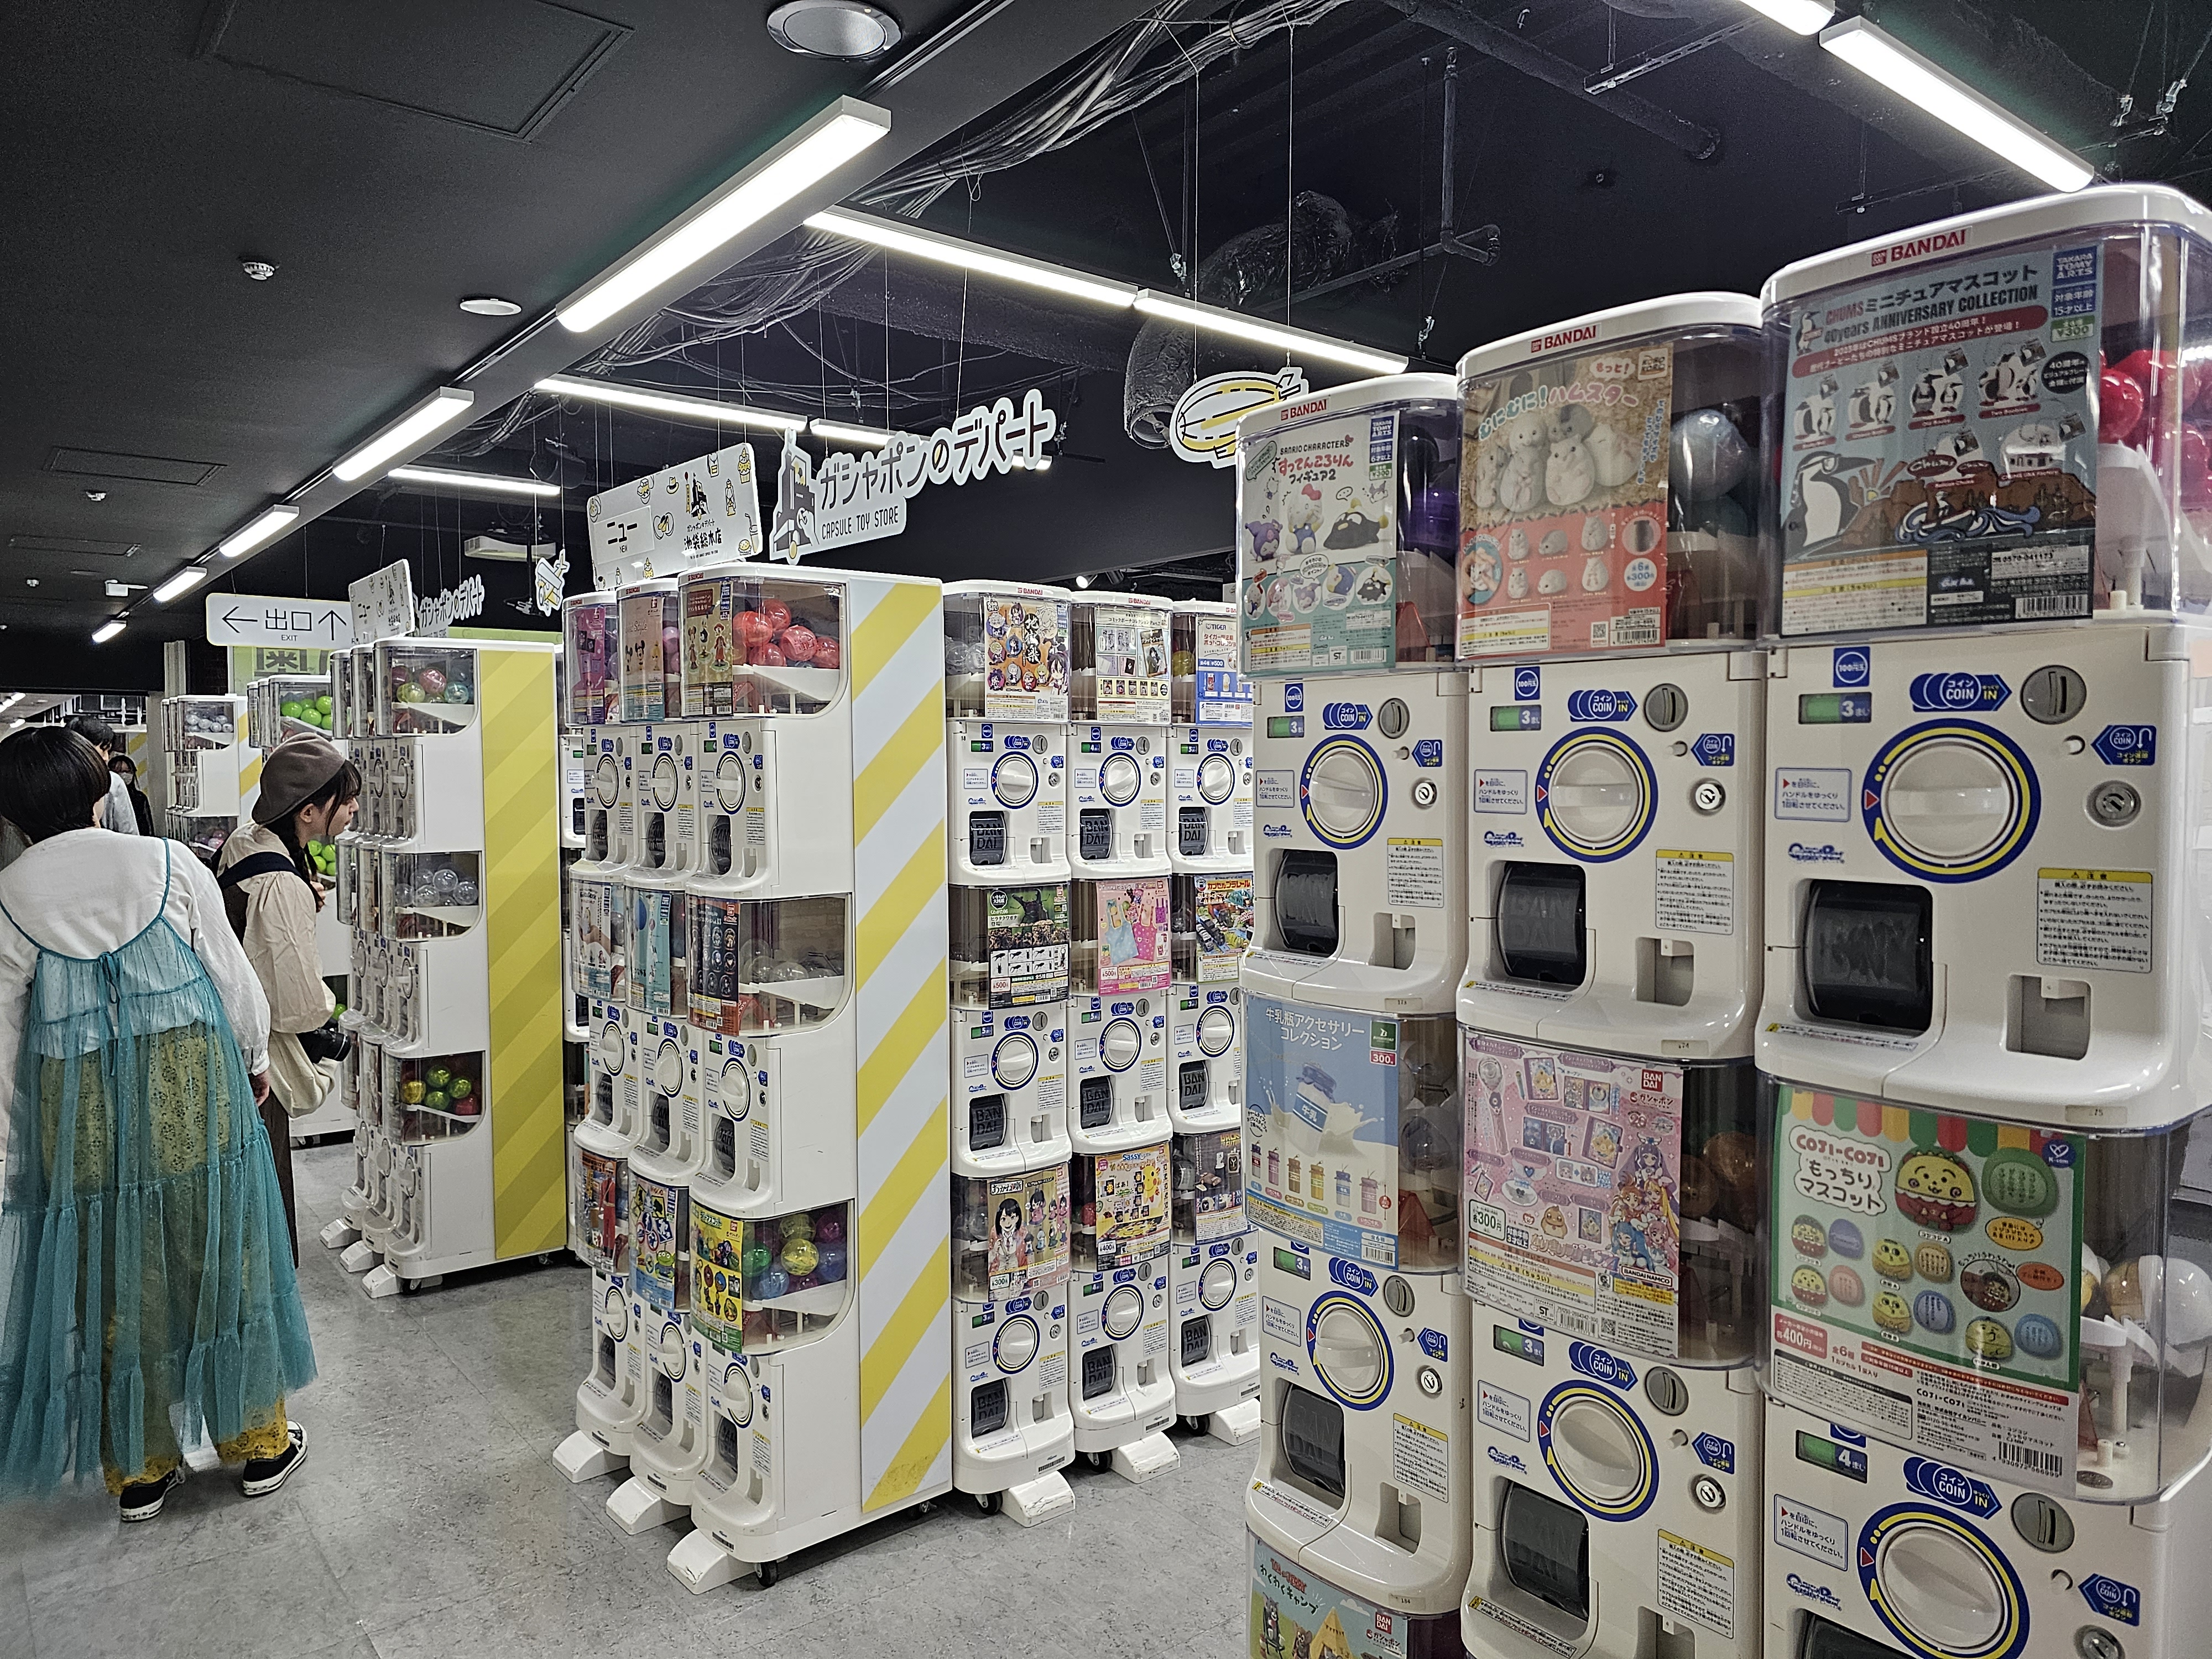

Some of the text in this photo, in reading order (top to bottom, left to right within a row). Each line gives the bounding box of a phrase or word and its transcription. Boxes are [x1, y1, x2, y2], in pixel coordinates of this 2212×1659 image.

[1891, 230, 1966, 261] BANDAI
[2057, 255, 2093, 265] TAKARA
[2057, 262, 2091, 273] TOMY
[1873, 301, 1953, 330] ANNIVERSARY
[1959, 285, 2037, 310] COLLECTION
[1545, 327, 1596, 349] BANDAI
[2057, 326, 2089, 338] ¥300
[1596, 362, 1630, 375] もっと!
[1290, 400, 1327, 419] BANDAI
[1478, 383, 1640, 441] むにむに!ハムスター
[1280, 439, 1350, 455] SANRIO CHARACTERS
[820, 400, 1047, 510] ガシャポンのデパート
[1279, 453, 1354, 476] すってんころりん
[1289, 468, 1336, 484] フィギュア2
[822, 505, 899, 539] CAPSULE TOY STORE
[607, 522, 637, 544] ニュー
[619, 544, 628, 552] NEW
[421, 581, 482, 628] ガシャポンのデパート
[265, 608, 312, 632] 出口
[1947, 680, 1974, 688] コイン
[1945, 688, 1974, 700] COIN
[1983, 690, 1997, 700] IN
[1592, 702, 1613, 712] COIN
[1618, 704, 1628, 713] IN
[1841, 701, 1869, 717] 3まい
[1340, 713, 1355, 722] COIN
[1479, 796, 1524, 806] 1回転させてください。
[1782, 791, 1839, 800] ハンドルをゆっくり
[1782, 800, 1845, 811] 1回転させてください。
[1086, 820, 1108, 831] BAN
[1183, 819, 1204, 830] BAN
[1086, 833, 1104, 845] DAI
[1183, 830, 1201, 841] DAI
[1207, 880, 1250, 890] カプセルプラレール
[1266, 1006, 1364, 1036] 牛乳瓶アクセサリー
[1281, 1027, 1343, 1051] コレクション
[1183, 1071, 1204, 1084] BAN
[1643, 1079, 1657, 1089] DAI
[1644, 1072, 1662, 1082] BAN
[1184, 1084, 1202, 1096] DAI
[1640, 1094, 1673, 1106] ガシャポン
[1302, 1104, 1317, 1122] 牛乳
[1123, 1152, 1140, 1161] Sassy
[1796, 1134, 1885, 1167] COJI-COJI
[1808, 1159, 1873, 1190] もっちり
[1115, 1180, 1129, 1188] ばあ!
[1800, 1178, 1881, 1210] マスコット
[1473, 1211, 1502, 1232] 各300円
[1347, 1266, 1361, 1275] コイン
[1624, 1267, 1670, 1285] BANDAI NAMCO
[1346, 1272, 1360, 1285] COIN
[1364, 1280, 1372, 1290] IN
[1539, 1306, 1550, 1316] ST
[1265, 1313, 1295, 1328] ハンドルをゆっくり
[1185, 1327, 1206, 1342] BAN
[1777, 1328, 1812, 1349] 各400円
[1186, 1339, 1203, 1355] DAI
[1524, 1338, 1543, 1357] 3まい
[1594, 1353, 1613, 1365] コイン
[1593, 1360, 1613, 1376] COIN
[1832, 1356, 1878, 1378] 1カプセル 1個入り
[1618, 1370, 1629, 1381] IN
[1917, 1387, 1965, 1408] COJI-COJI
[1483, 1401, 1521, 1421] ハンドルをゆっくり
[1482, 1407, 1527, 1432] 1回転させてください。
[1705, 1443, 1719, 1453] COIN
[1839, 1449, 1866, 1472] 4まい
[1939, 1473, 1966, 1486] コイン
[1938, 1480, 1966, 1500] COIN
[1974, 1495, 1988, 1509] IN
[1781, 1520, 1836, 1546] ハンドルをゆっくり
[1781, 1528, 1844, 1559] 1回転させてください。
[1260, 1564, 1319, 1616] わくわくキャンプ
[1286, 1571, 1307, 1595] JERRY
[2099, 1589, 2117, 1600] COIN
[1376, 1613, 1391, 1625] BAN
[1376, 1620, 1389, 1631] DAI
[1374, 1632, 1401, 1646] ガシャポン
